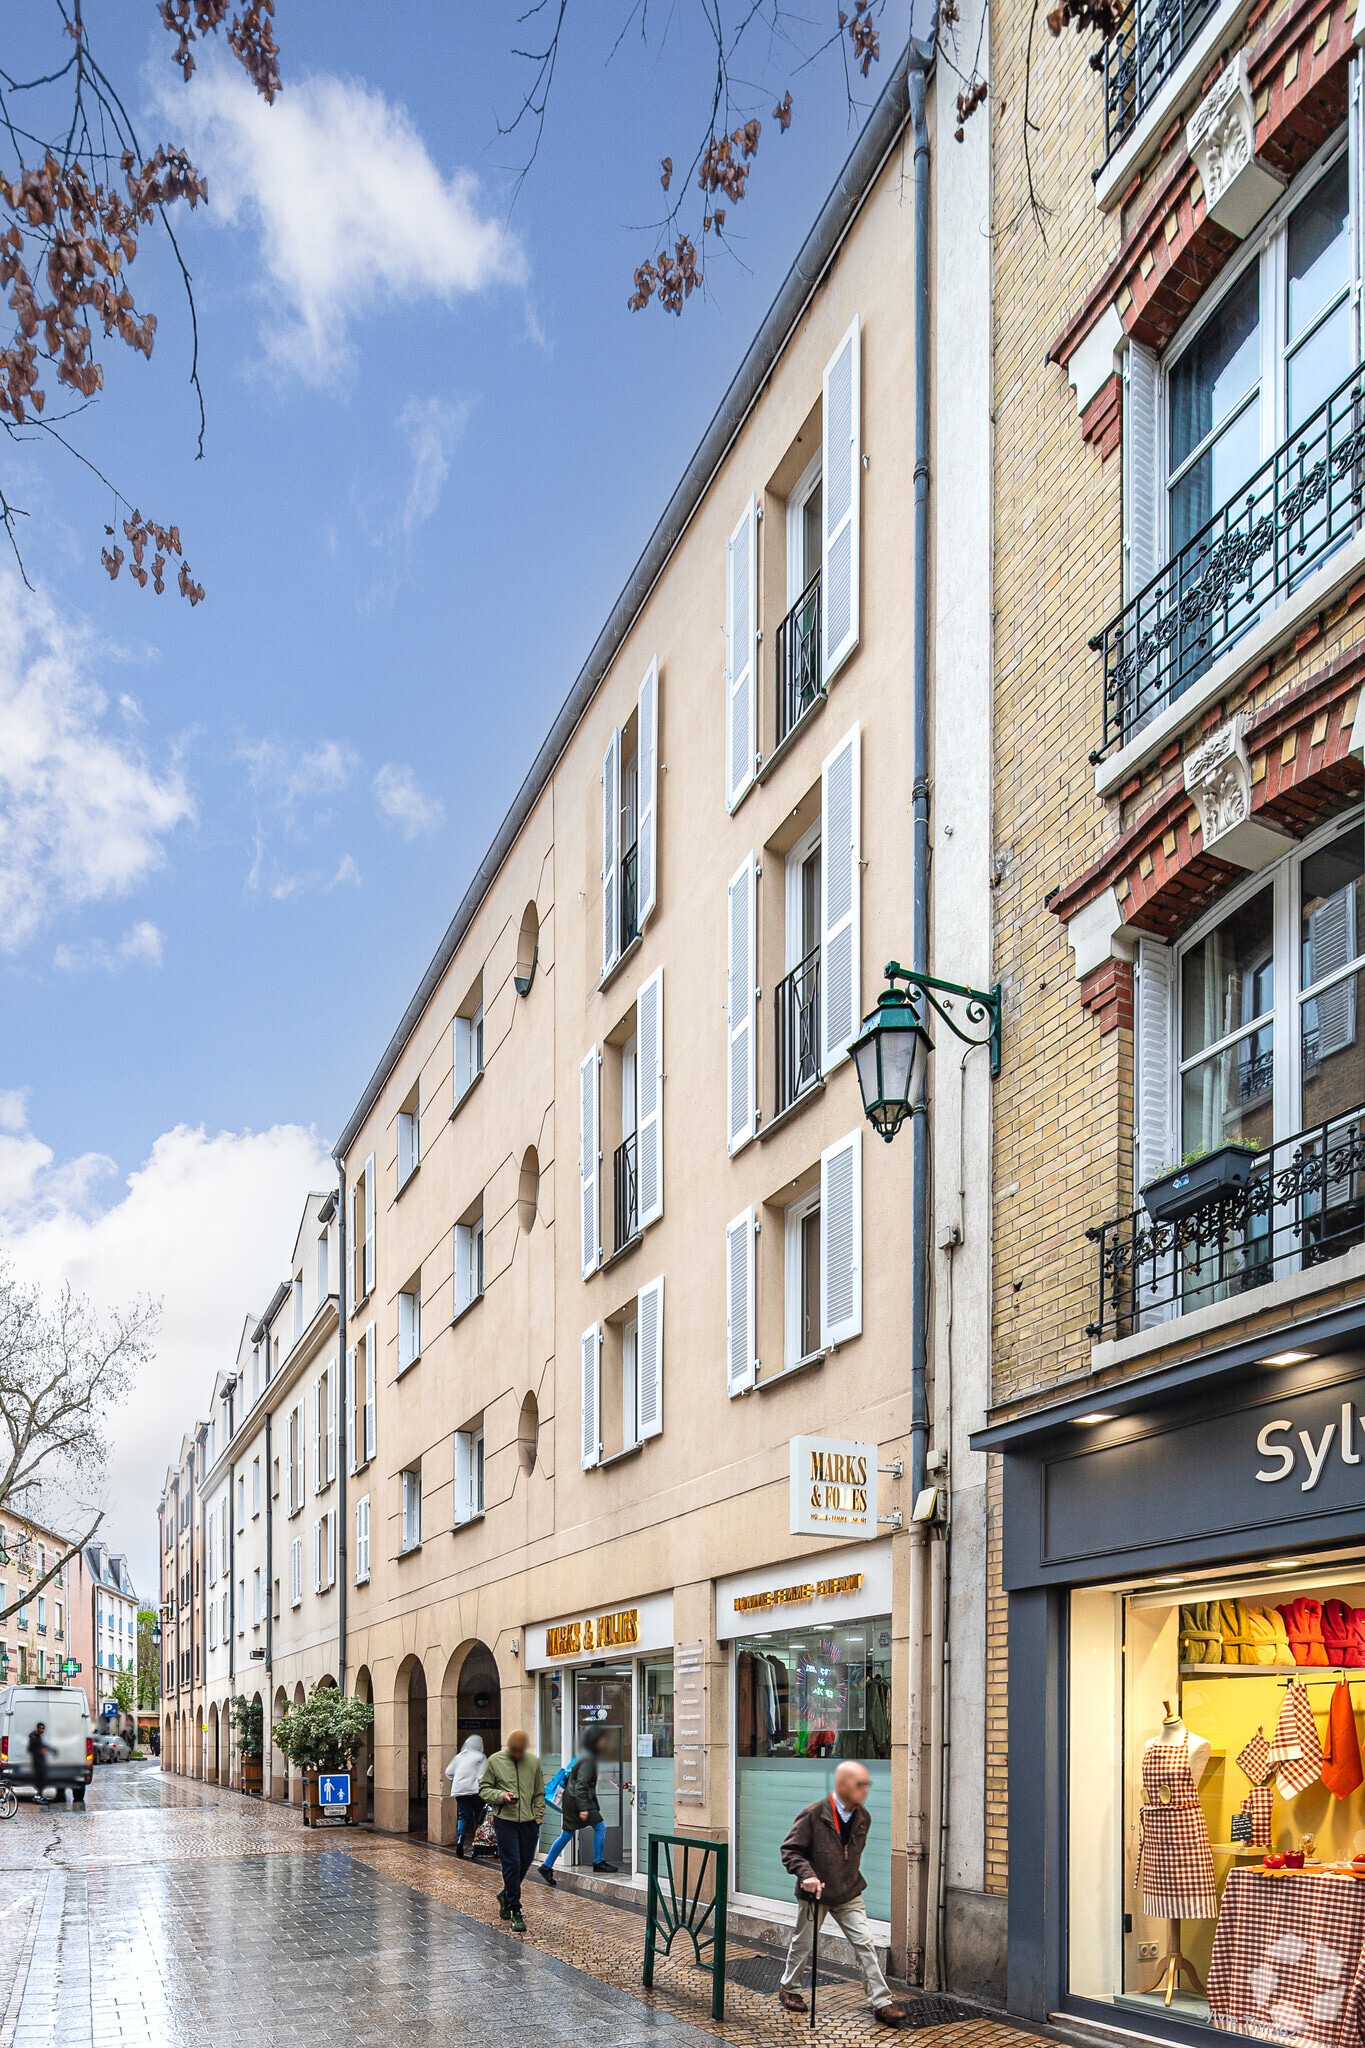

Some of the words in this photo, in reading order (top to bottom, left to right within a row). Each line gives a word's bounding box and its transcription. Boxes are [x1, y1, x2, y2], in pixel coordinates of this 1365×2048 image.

[1254, 1402, 1365, 1491] Syl
[810, 1451, 867, 1486] MARKS
[810, 1484, 822, 1508] &
[824, 1485, 867, 1513] FOES
[546, 1622, 582, 1657] MARKS
[583, 1620, 595, 1650] &
[596, 1609, 639, 1648] FOLIES
[105, 1704, 112, 1713] P
[1196, 2004, 1239, 2027] Sylvie
[1243, 2014, 1298, 2041] Thiriez
